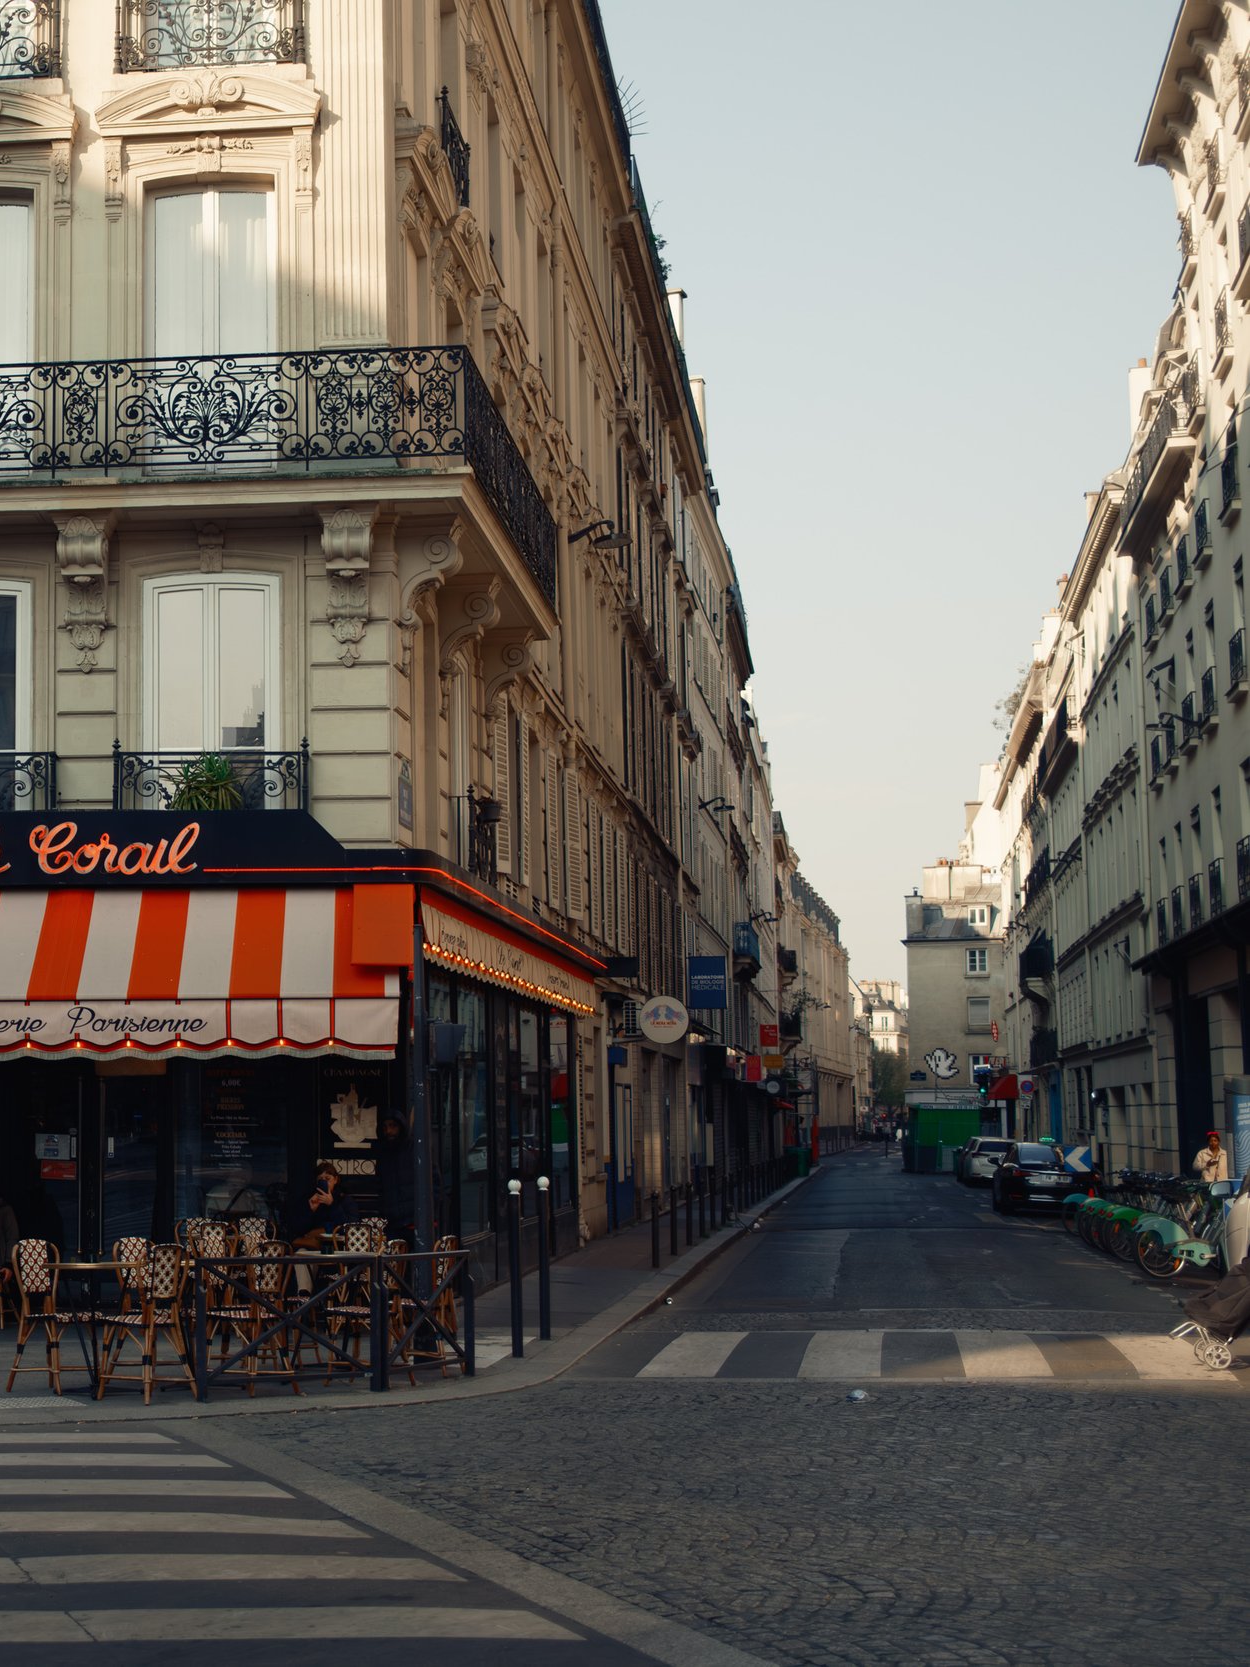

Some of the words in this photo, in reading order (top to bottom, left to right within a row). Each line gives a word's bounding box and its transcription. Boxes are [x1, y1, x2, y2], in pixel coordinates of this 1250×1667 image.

[29, 821, 200, 876] Corail
[67, 1006, 207, 1035] Parisienne
[324, 1067, 382, 1078] CHAMPAGNE
